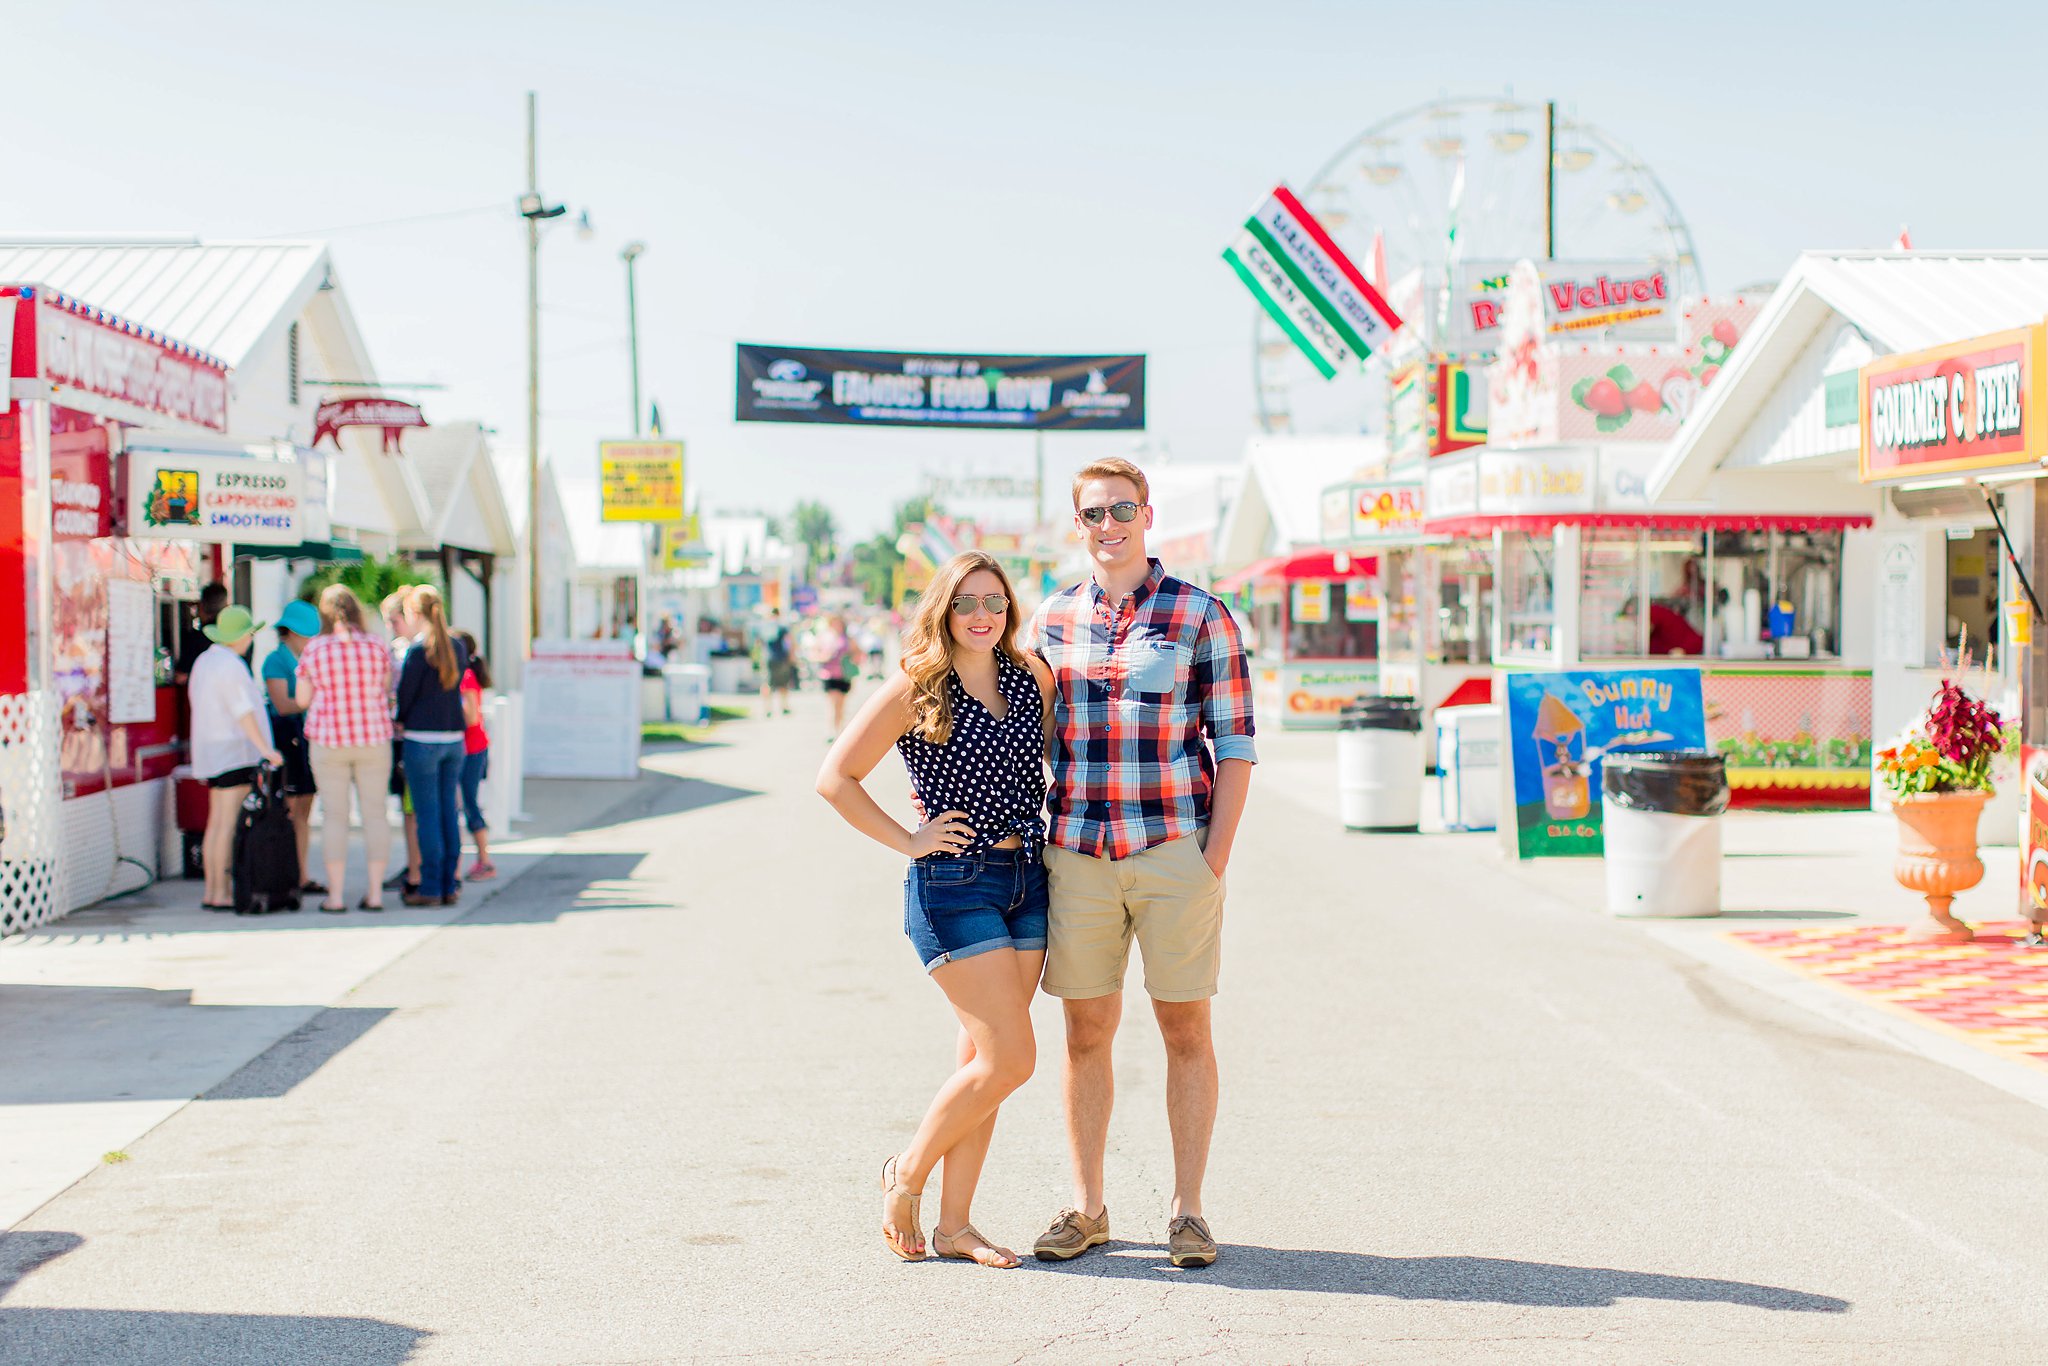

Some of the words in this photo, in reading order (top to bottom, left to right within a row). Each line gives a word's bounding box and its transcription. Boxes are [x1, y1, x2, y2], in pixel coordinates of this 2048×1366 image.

[1248, 247, 1296, 302] CORN
[1550, 272, 1666, 312] Velvet
[930, 375, 989, 409] FOOD
[1872, 375, 1948, 450] GOURMET
[216, 472, 286, 489] ESPRESSO
[206, 491, 297, 510] CAPPUCCINO
[210, 512, 292, 528] SMOOTHIES
[1580, 677, 1673, 712] Bunny
[1614, 703, 1652, 730] Hut
